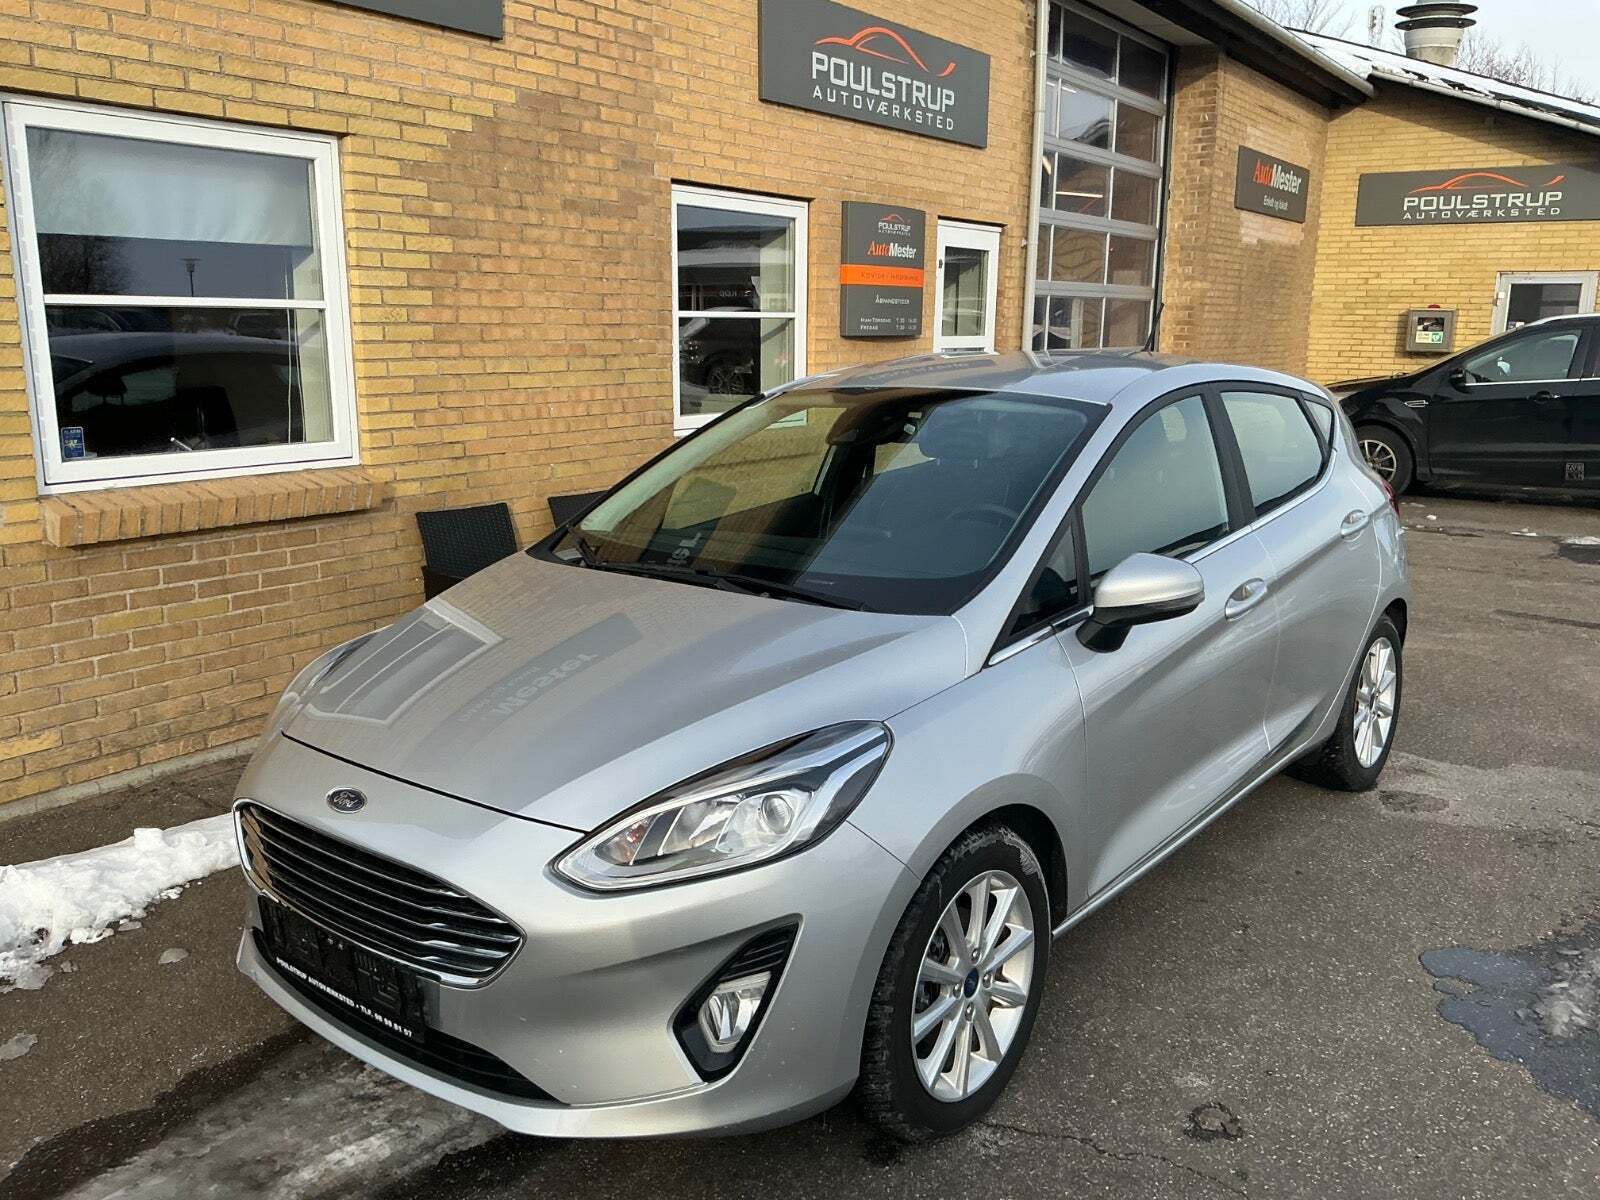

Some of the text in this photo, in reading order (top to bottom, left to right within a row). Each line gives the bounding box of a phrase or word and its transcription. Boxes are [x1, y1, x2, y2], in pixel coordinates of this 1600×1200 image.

[812, 51, 955, 113] POULSTRUP
[812, 85, 954, 131] AUTOVÆRKSTED
[1253, 160, 1302, 194] AutoMester
[1403, 191, 1562, 211] POULSTRUP
[1403, 207, 1561, 220] AUTOVÆRKSTED
[878, 222, 911, 232] POULSTRUP
[867, 241, 917, 259] AutoMester
